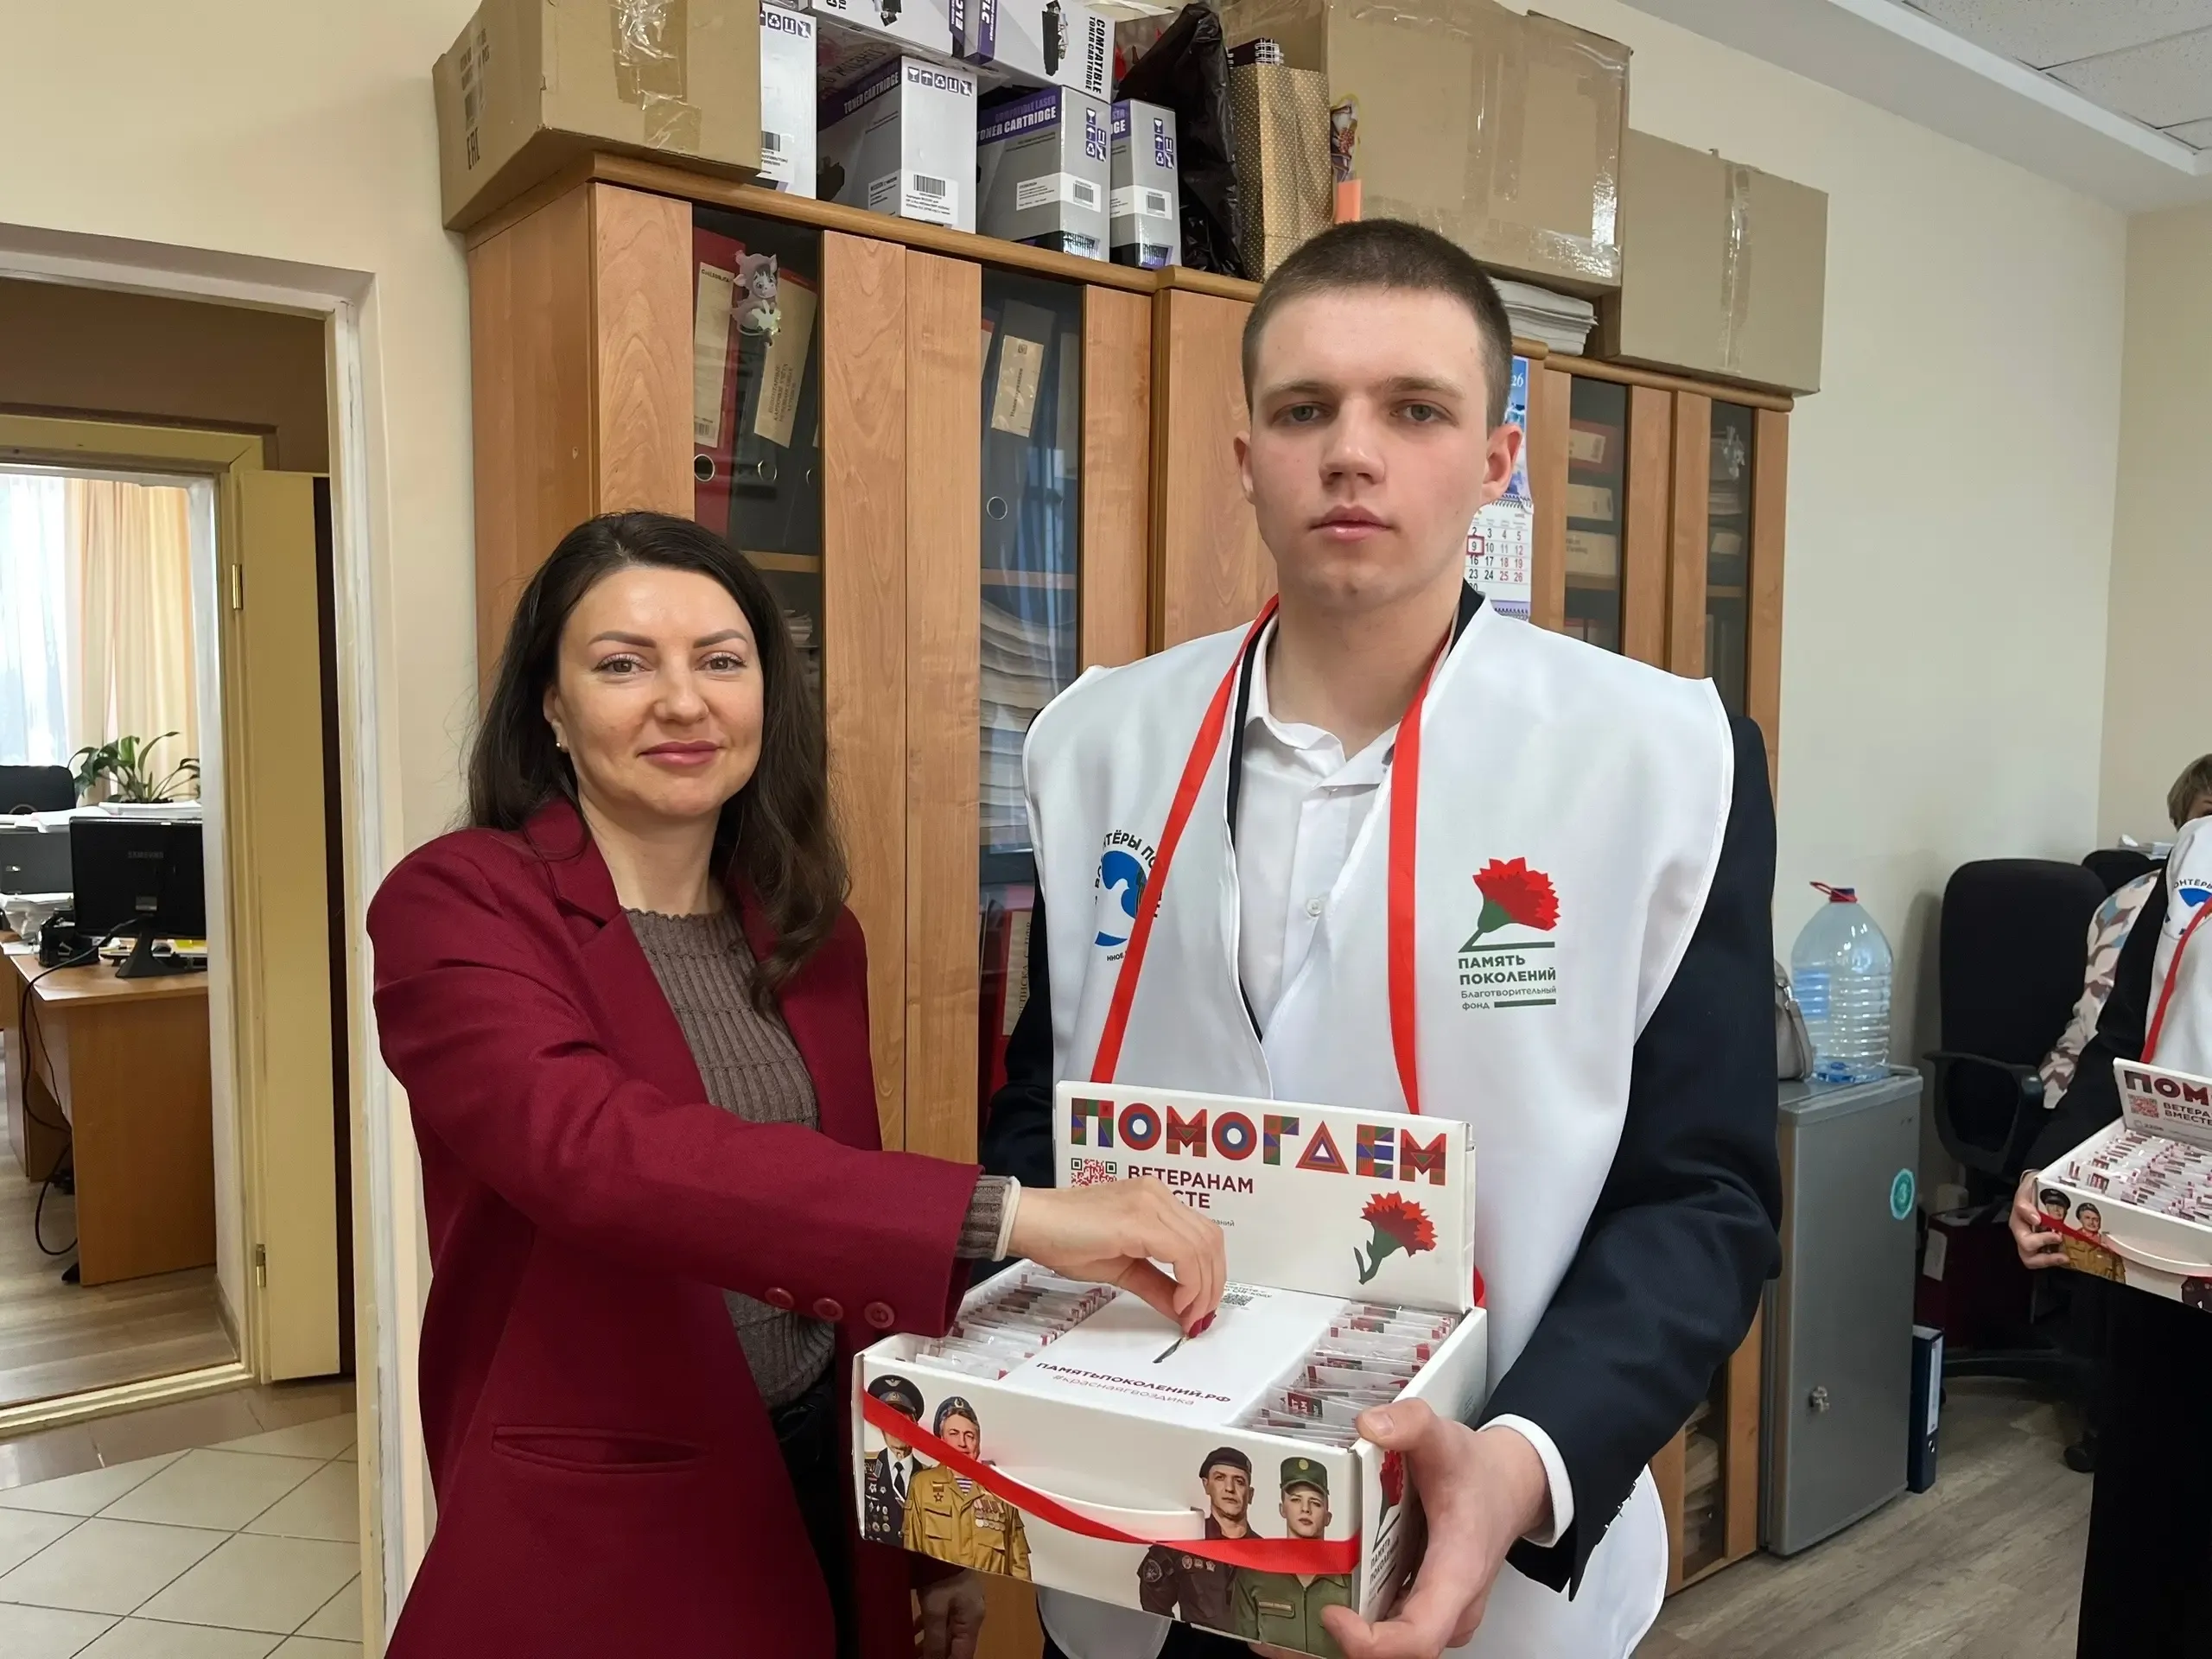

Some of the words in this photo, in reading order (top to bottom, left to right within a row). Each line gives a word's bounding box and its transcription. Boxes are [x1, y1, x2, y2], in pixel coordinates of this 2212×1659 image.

[1087, 16, 1096, 43] TONER
[1093, 19, 1106, 93] COMPATIBLE
[1085, 44, 1095, 90] CARTRIDGE
[1003, 105, 1057, 133] CARTRIDGE
[1487, 528, 1492, 538] 3
[1502, 529, 1507, 540] 4
[1516, 531, 1522, 541] 5
[1471, 541, 1477, 551] 9
[1486, 542, 1495, 553] 10
[1500, 543, 1509, 554] 11
[1515, 545, 1523, 556] 12
[1470, 555, 1479, 565] 16
[1485, 556, 1494, 566] 17
[1500, 557, 1509, 568] 18
[1515, 558, 1523, 569] 19
[1469, 569, 1478, 579] 23
[1484, 569, 1494, 580] 24
[1499, 570, 1509, 581] 25
[1514, 572, 1522, 582] 26
[1458, 955, 1526, 969] ПАМЯТЬ
[1459, 967, 1556, 985] ПОКОЛЕНИЙ
[1461, 986, 1557, 999] Благотворительный
[1462, 1001, 1491, 1011] фонд
[2163, 1102, 2212, 1118] ВЕТЕРА
[1071, 1097, 1447, 1186] ПОМОГАЕМ
[1128, 1165, 1254, 1194] ВЕТЕРАНАМ
[1035, 1362, 1231, 1403] ПАМЯТЬПОКОЛЕНИЙ.РФ
[1052, 1374, 1196, 1407] #краснаягвоздика
